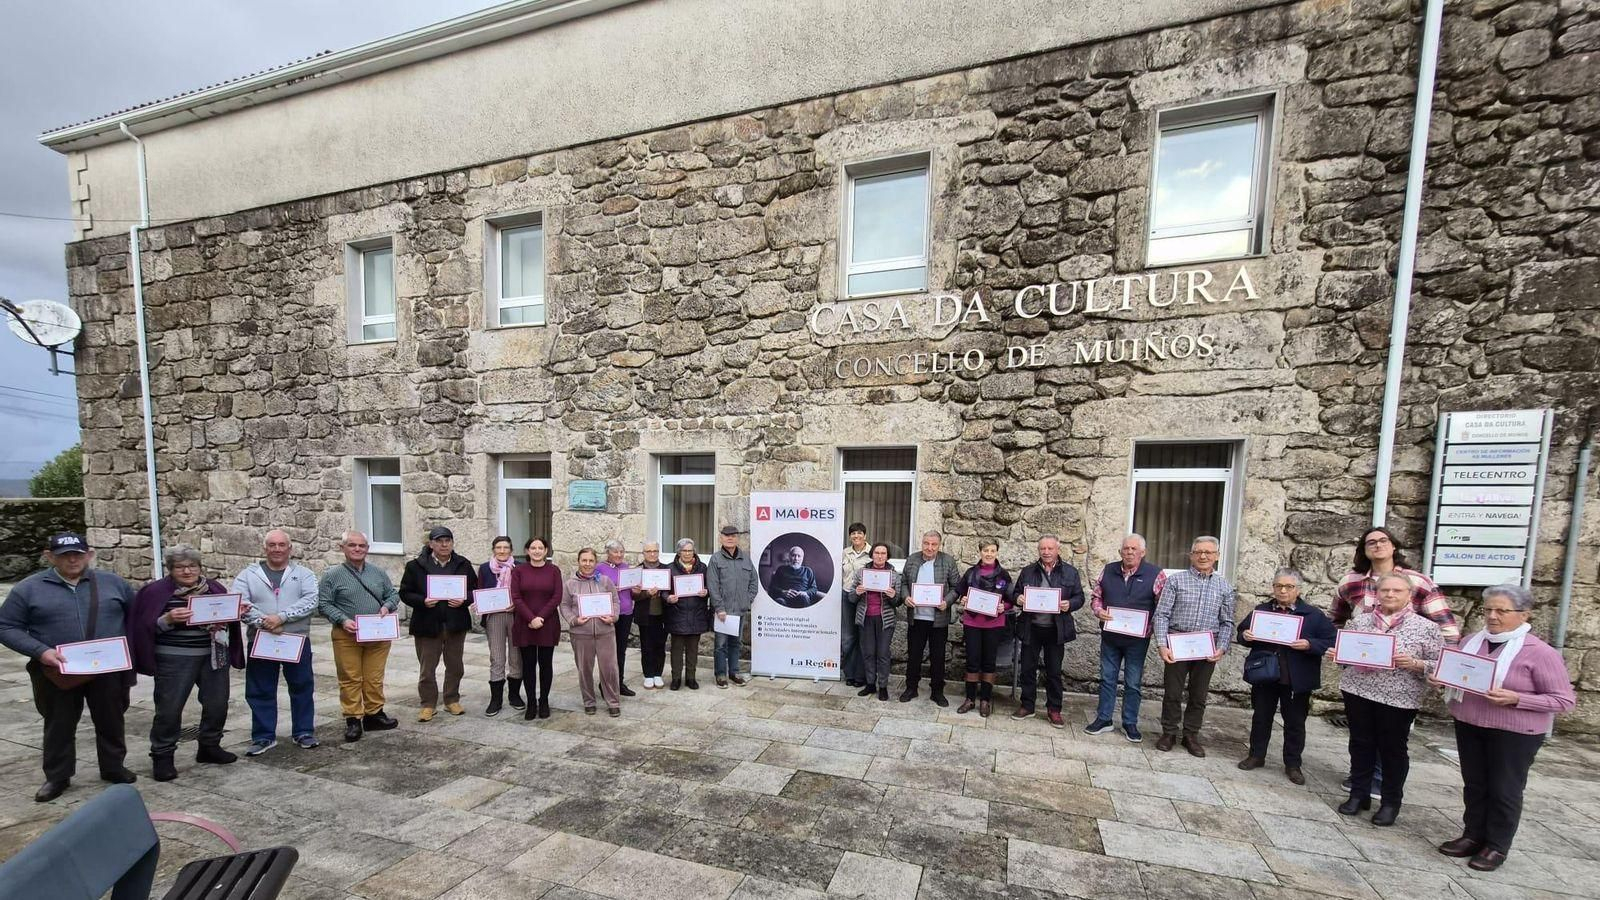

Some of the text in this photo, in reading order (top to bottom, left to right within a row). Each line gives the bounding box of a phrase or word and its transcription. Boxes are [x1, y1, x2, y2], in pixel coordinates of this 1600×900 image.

[811, 264, 1260, 336] CASA DA CULTURA
[835, 331, 1215, 379] CONCELLO DE MUIÑOS
[1495, 420, 1526, 428] CULTURA
[1453, 471, 1527, 479] TELECENTRO
[758, 507, 835, 520] A MAIORES
[790, 658, 803, 666] La
